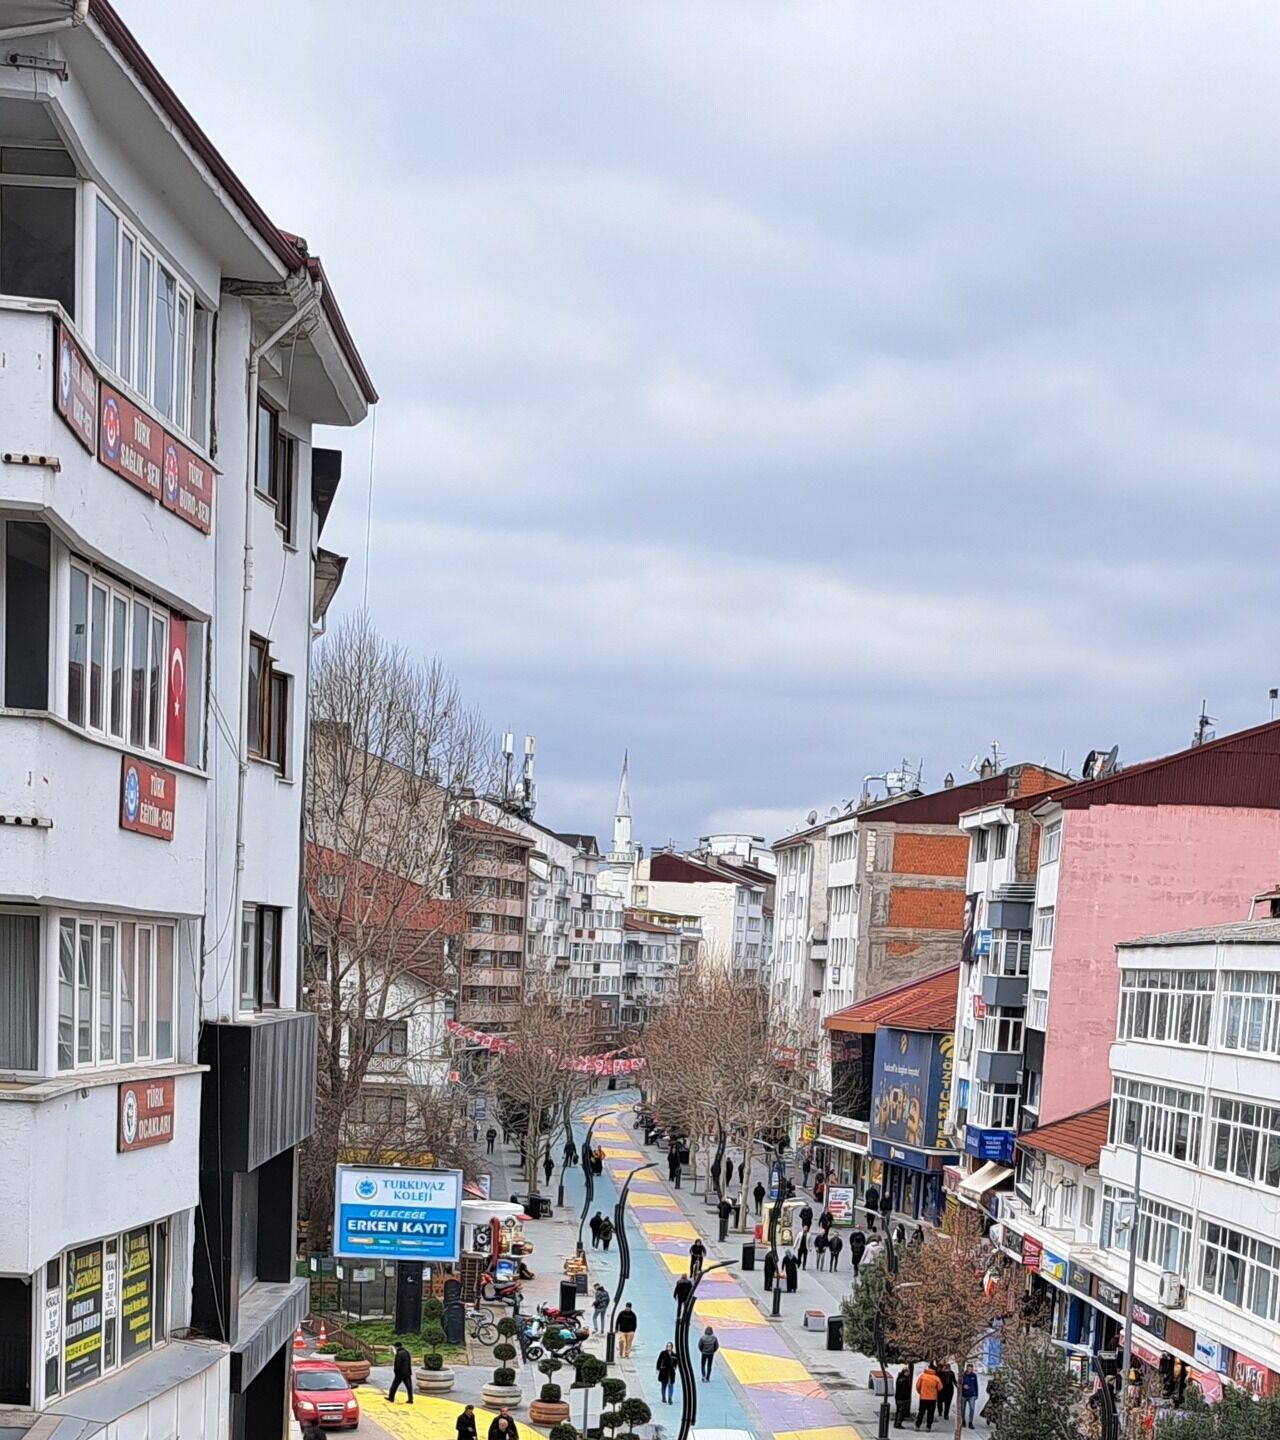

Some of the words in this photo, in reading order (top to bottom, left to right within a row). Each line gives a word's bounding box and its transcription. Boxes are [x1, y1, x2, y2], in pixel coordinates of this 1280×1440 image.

[134, 415, 152, 450] TÜRK
[188, 459, 204, 491] TÜRK
[150, 772, 165, 799] TÜRK
[146, 1084, 165, 1110] TÜRK
[138, 1114, 172, 1140] OCAKLARI
[382, 1179, 445, 1192] TURKUVAZ
[393, 1190, 433, 1203] KOLEJİ
[369, 1208, 427, 1219] GELECEĞE
[347, 1219, 398, 1233] ERKEN
[402, 1221, 447, 1235] KAYIT
